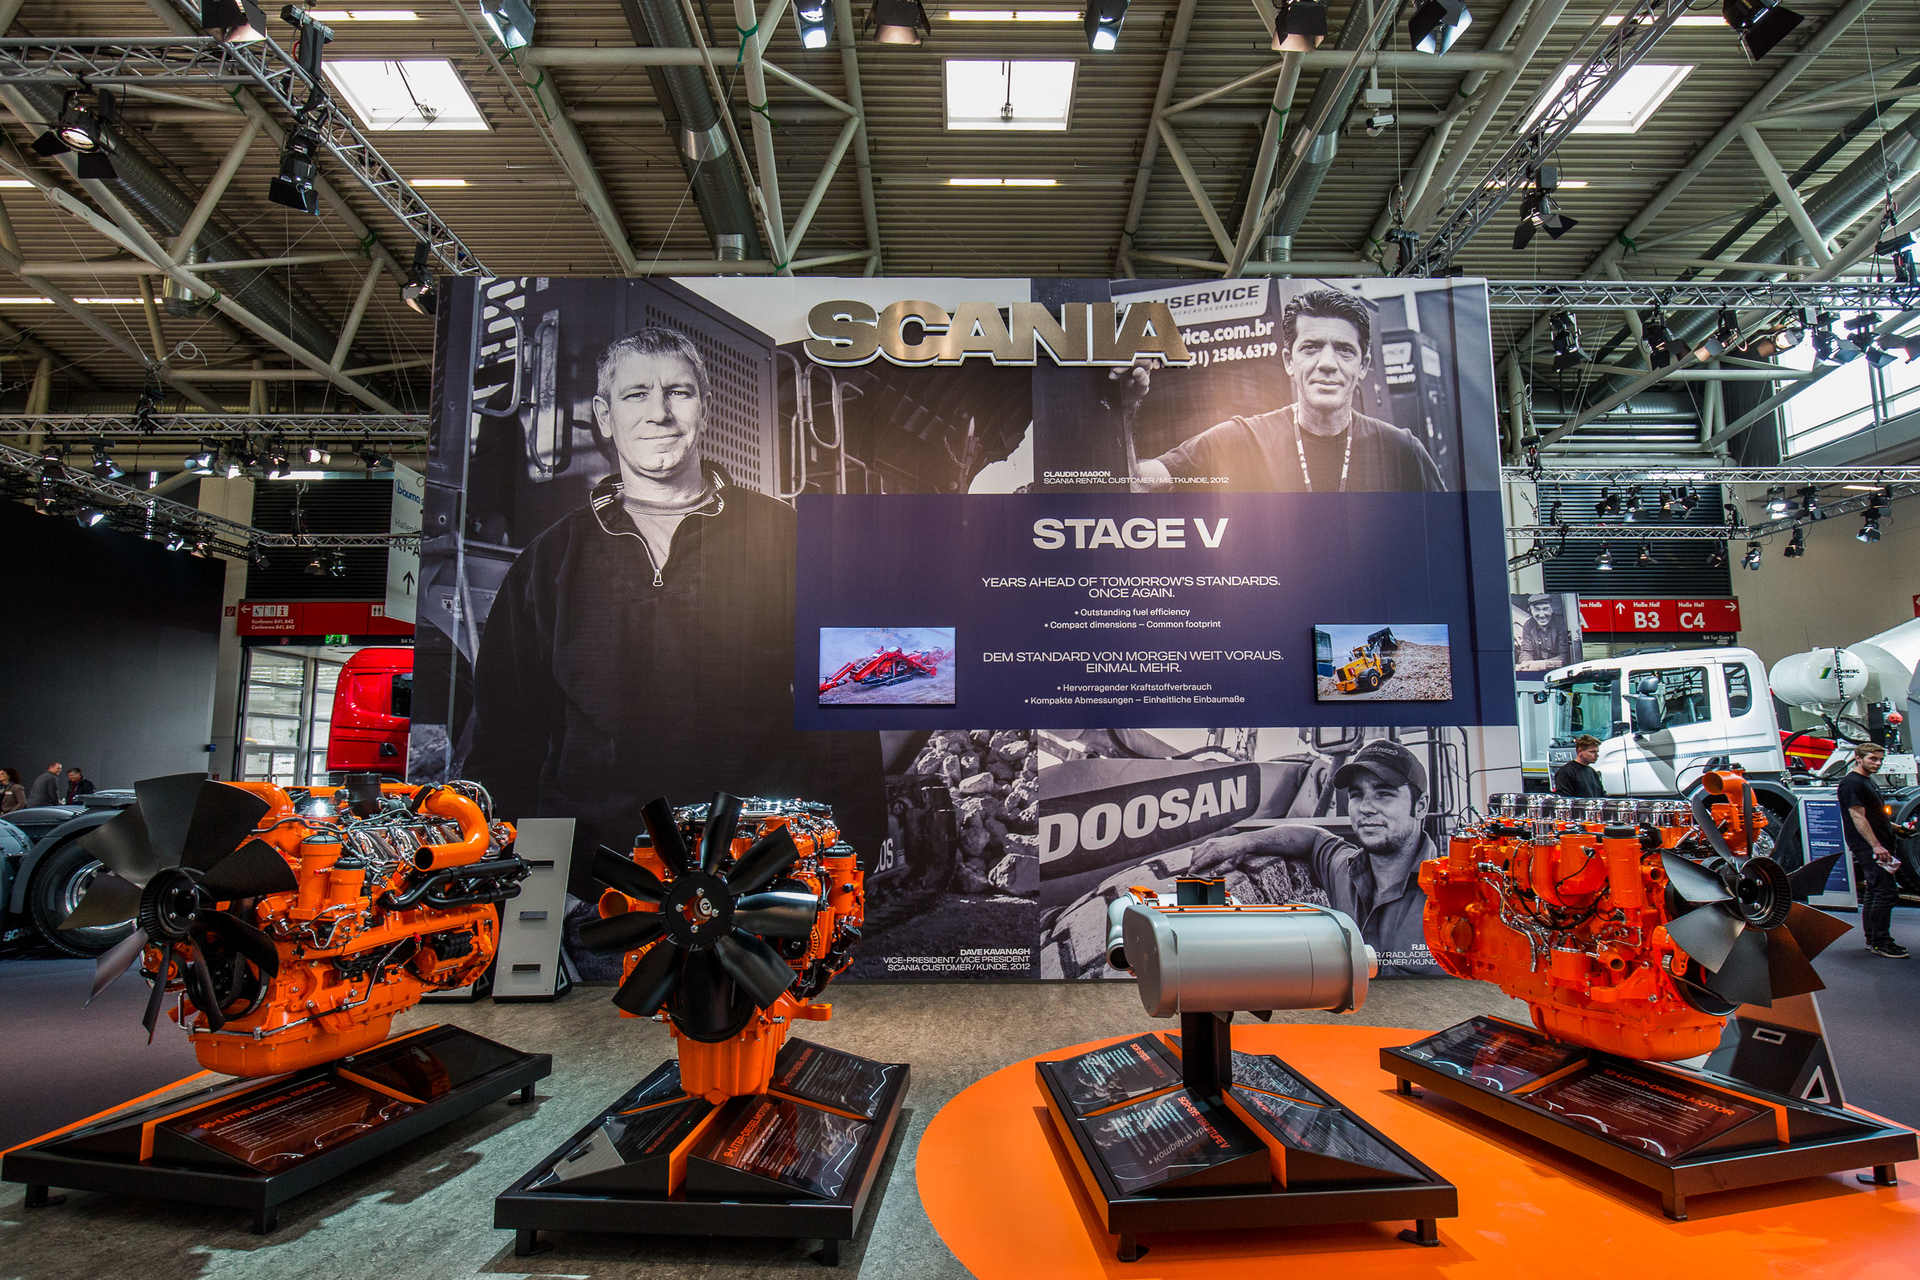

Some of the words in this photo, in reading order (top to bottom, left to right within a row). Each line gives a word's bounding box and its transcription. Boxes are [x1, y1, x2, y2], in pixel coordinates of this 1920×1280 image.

[1172, 308, 1203, 317] OCAÇÃO
[803, 299, 1193, 367] SCANIA
[1180, 318, 1275, 346] vice.com.br
[1186, 351, 1209, 368] 21)
[1212, 342, 1278, 363] 2586.6379
[1043, 470, 1080, 478] CLAUDIO
[1080, 470, 1111, 478] MAGON
[1043, 477, 1075, 485] SCANIA
[1075, 477, 1107, 485] RENTAL
[1209, 476, 1230, 484] 2012
[397, 481, 420, 504] bauma
[1033, 517, 1186, 550] STAGE
[1193, 517, 1229, 548] V
[981, 577, 1027, 588] YEARS
[1028, 577, 1076, 588] AHEAD
[1077, 577, 1097, 587] OF
[1099, 576, 1194, 587] TOMORROW'S
[1195, 576, 1281, 587] STANDARDS.
[1088, 588, 1129, 599] ONCE
[1131, 587, 1176, 598] AGAIN.
[1080, 608, 1131, 617] Outstanding
[1132, 608, 1149, 616] fuel
[1149, 608, 1191, 617] efficiency
[1050, 620, 1088, 630] Compact
[1089, 620, 1138, 629] dimensions
[1146, 620, 1184, 629] Common
[1185, 620, 1222, 630] footprint
[1633, 611, 1661, 629] B3
[1680, 612, 1706, 629] C4
[983, 652, 1014, 663] DEM
[1016, 652, 1091, 663] STANDARD
[1092, 651, 1123, 662] VON
[1125, 651, 1188, 662] MORGEN
[1188, 651, 1223, 661] WEIT
[1224, 650, 1284, 661] VORAUS.
[1086, 662, 1138, 673] EINMAL
[1139, 662, 1182, 673] MEHR.
[1063, 683, 1129, 693] Hervorragender
[1130, 683, 1212, 692] Kraftstoffverbrauch
[1030, 696, 1074, 706] Kompakte
[1074, 696, 1134, 706] Abmessungen
[1143, 695, 1192, 704] Einheitliche
[1193, 695, 1246, 704] Einbaumaße
[1039, 775, 1248, 865] DOOSAN
[960, 948, 983, 956] DAVE
[983, 948, 1031, 956] KAVANAGH
[981, 955, 1031, 964] PRESIDENT
[1379, 958, 1438, 966] TOMER/KUND
[887, 963, 921, 972] SCANIA
[1010, 963, 1031, 971] 2012
[1603, 1068, 1736, 1117] 13-LITER-DIESELMOTOR
[199, 1108, 252, 1130] 16-LITRE
[250, 1095, 292, 1111] DIESEL
[1177, 1095, 1213, 1131] SCR-SYSTEM
[1205, 1124, 1228, 1145] STUFE
[1219, 1141, 1231, 1149] V
[723, 1101, 773, 1159] 9-LITER-DIESELMOTOR
